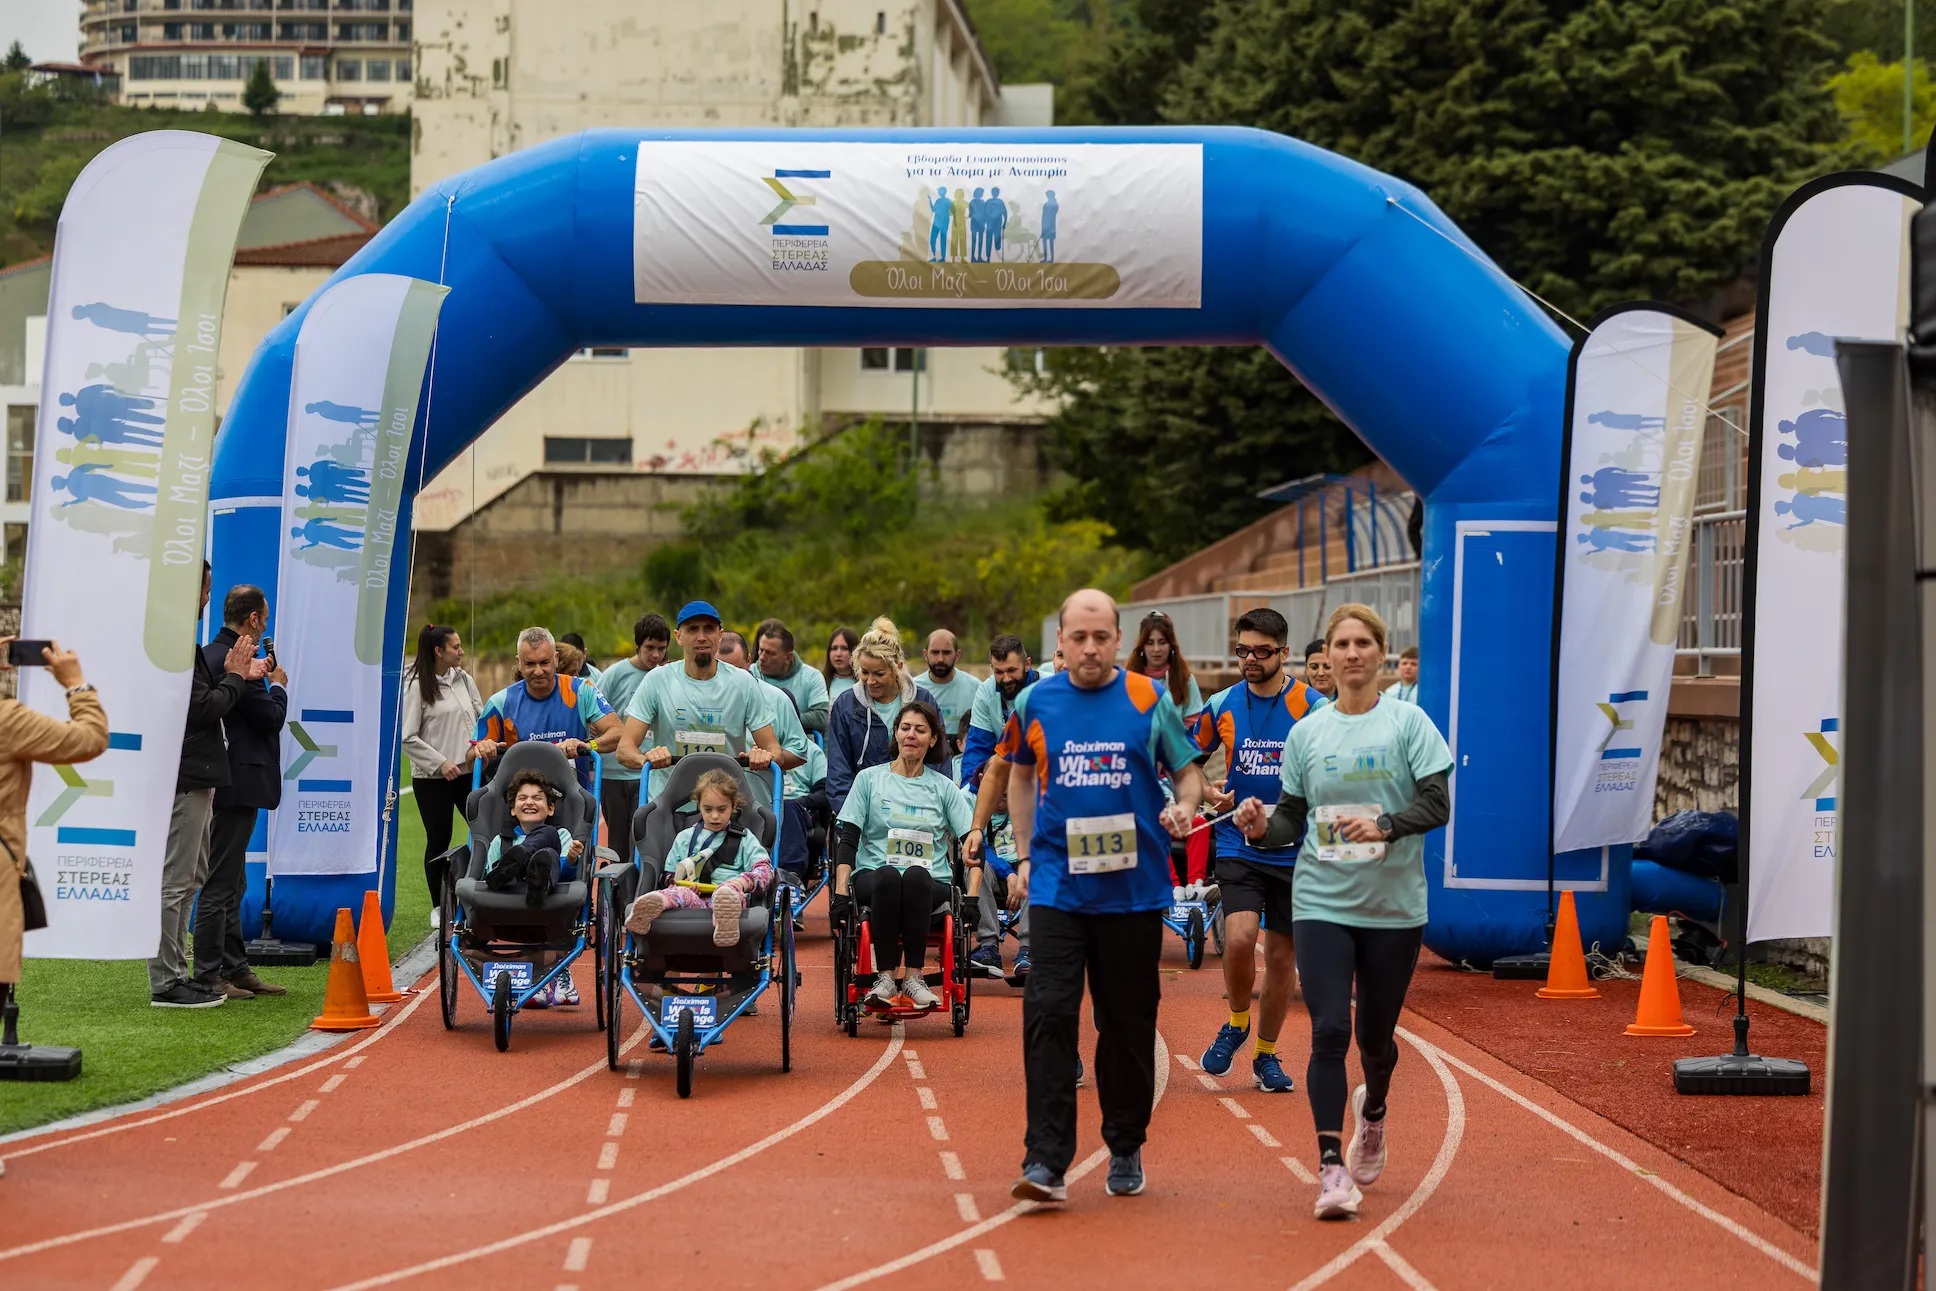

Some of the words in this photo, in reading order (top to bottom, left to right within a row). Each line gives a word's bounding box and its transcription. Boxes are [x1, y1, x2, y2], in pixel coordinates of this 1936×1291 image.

[906, 167, 924, 178] για
[929, 167, 942, 176] τα
[946, 166, 984, 178] Άτομα
[988, 167, 1004, 178] με
[1009, 166, 1067, 179] Αναπηρία
[772, 239, 828, 248] ΠΕΡΙΦΕΡΕΙΑ
[772, 249, 828, 260] ΣΤΕΡΕΑΣ
[772, 260, 828, 271] ΕΛΛΑΔΑΣ
[885, 267, 922, 290] Όλοι
[931, 267, 967, 298] Μαζί
[994, 268, 1031, 292] Όλοι
[1036, 268, 1068, 292] Ίσοι
[187, 313, 216, 354] Ίσοι
[180, 365, 213, 413] Όλοι
[386, 407, 409, 437] Ίσοι
[379, 444, 402, 480] Όλοι
[170, 453, 211, 504] Μαζί
[371, 507, 397, 545] Μαζί
[163, 517, 197, 566] Όλοι
[365, 553, 389, 589] Όλοι
[528, 730, 566, 741] Stoiximan
[1062, 740, 1126, 754] Stoiximan
[1058, 753, 1127, 773] Wheels
[1063, 769, 1132, 789] Change
[1595, 781, 1636, 793] ΕΛΛΑΔΑΣ
[298, 800, 351, 809] ΠΕΡΙΦΕΡΕΙΑ
[298, 811, 351, 821] ΣΤΕΡΕΑΣ
[298, 822, 351, 832] ΕΛΛΑΔΑΣ
[895, 840, 923, 857] 108
[1080, 832, 1124, 856] 113
[57, 855, 134, 869] ΠΕΡΙΦΕΡΕΙΑ
[56, 871, 131, 886] ΣΤΕΡΕΑΣ
[56, 886, 130, 901] ΕΛΛΑΔΑΣ
[491, 962, 527, 970] Stoiximan
[490, 976, 531, 987] Cnge
[671, 997, 710, 1005] Stoiximan
[670, 1014, 715, 1025] Cnge
